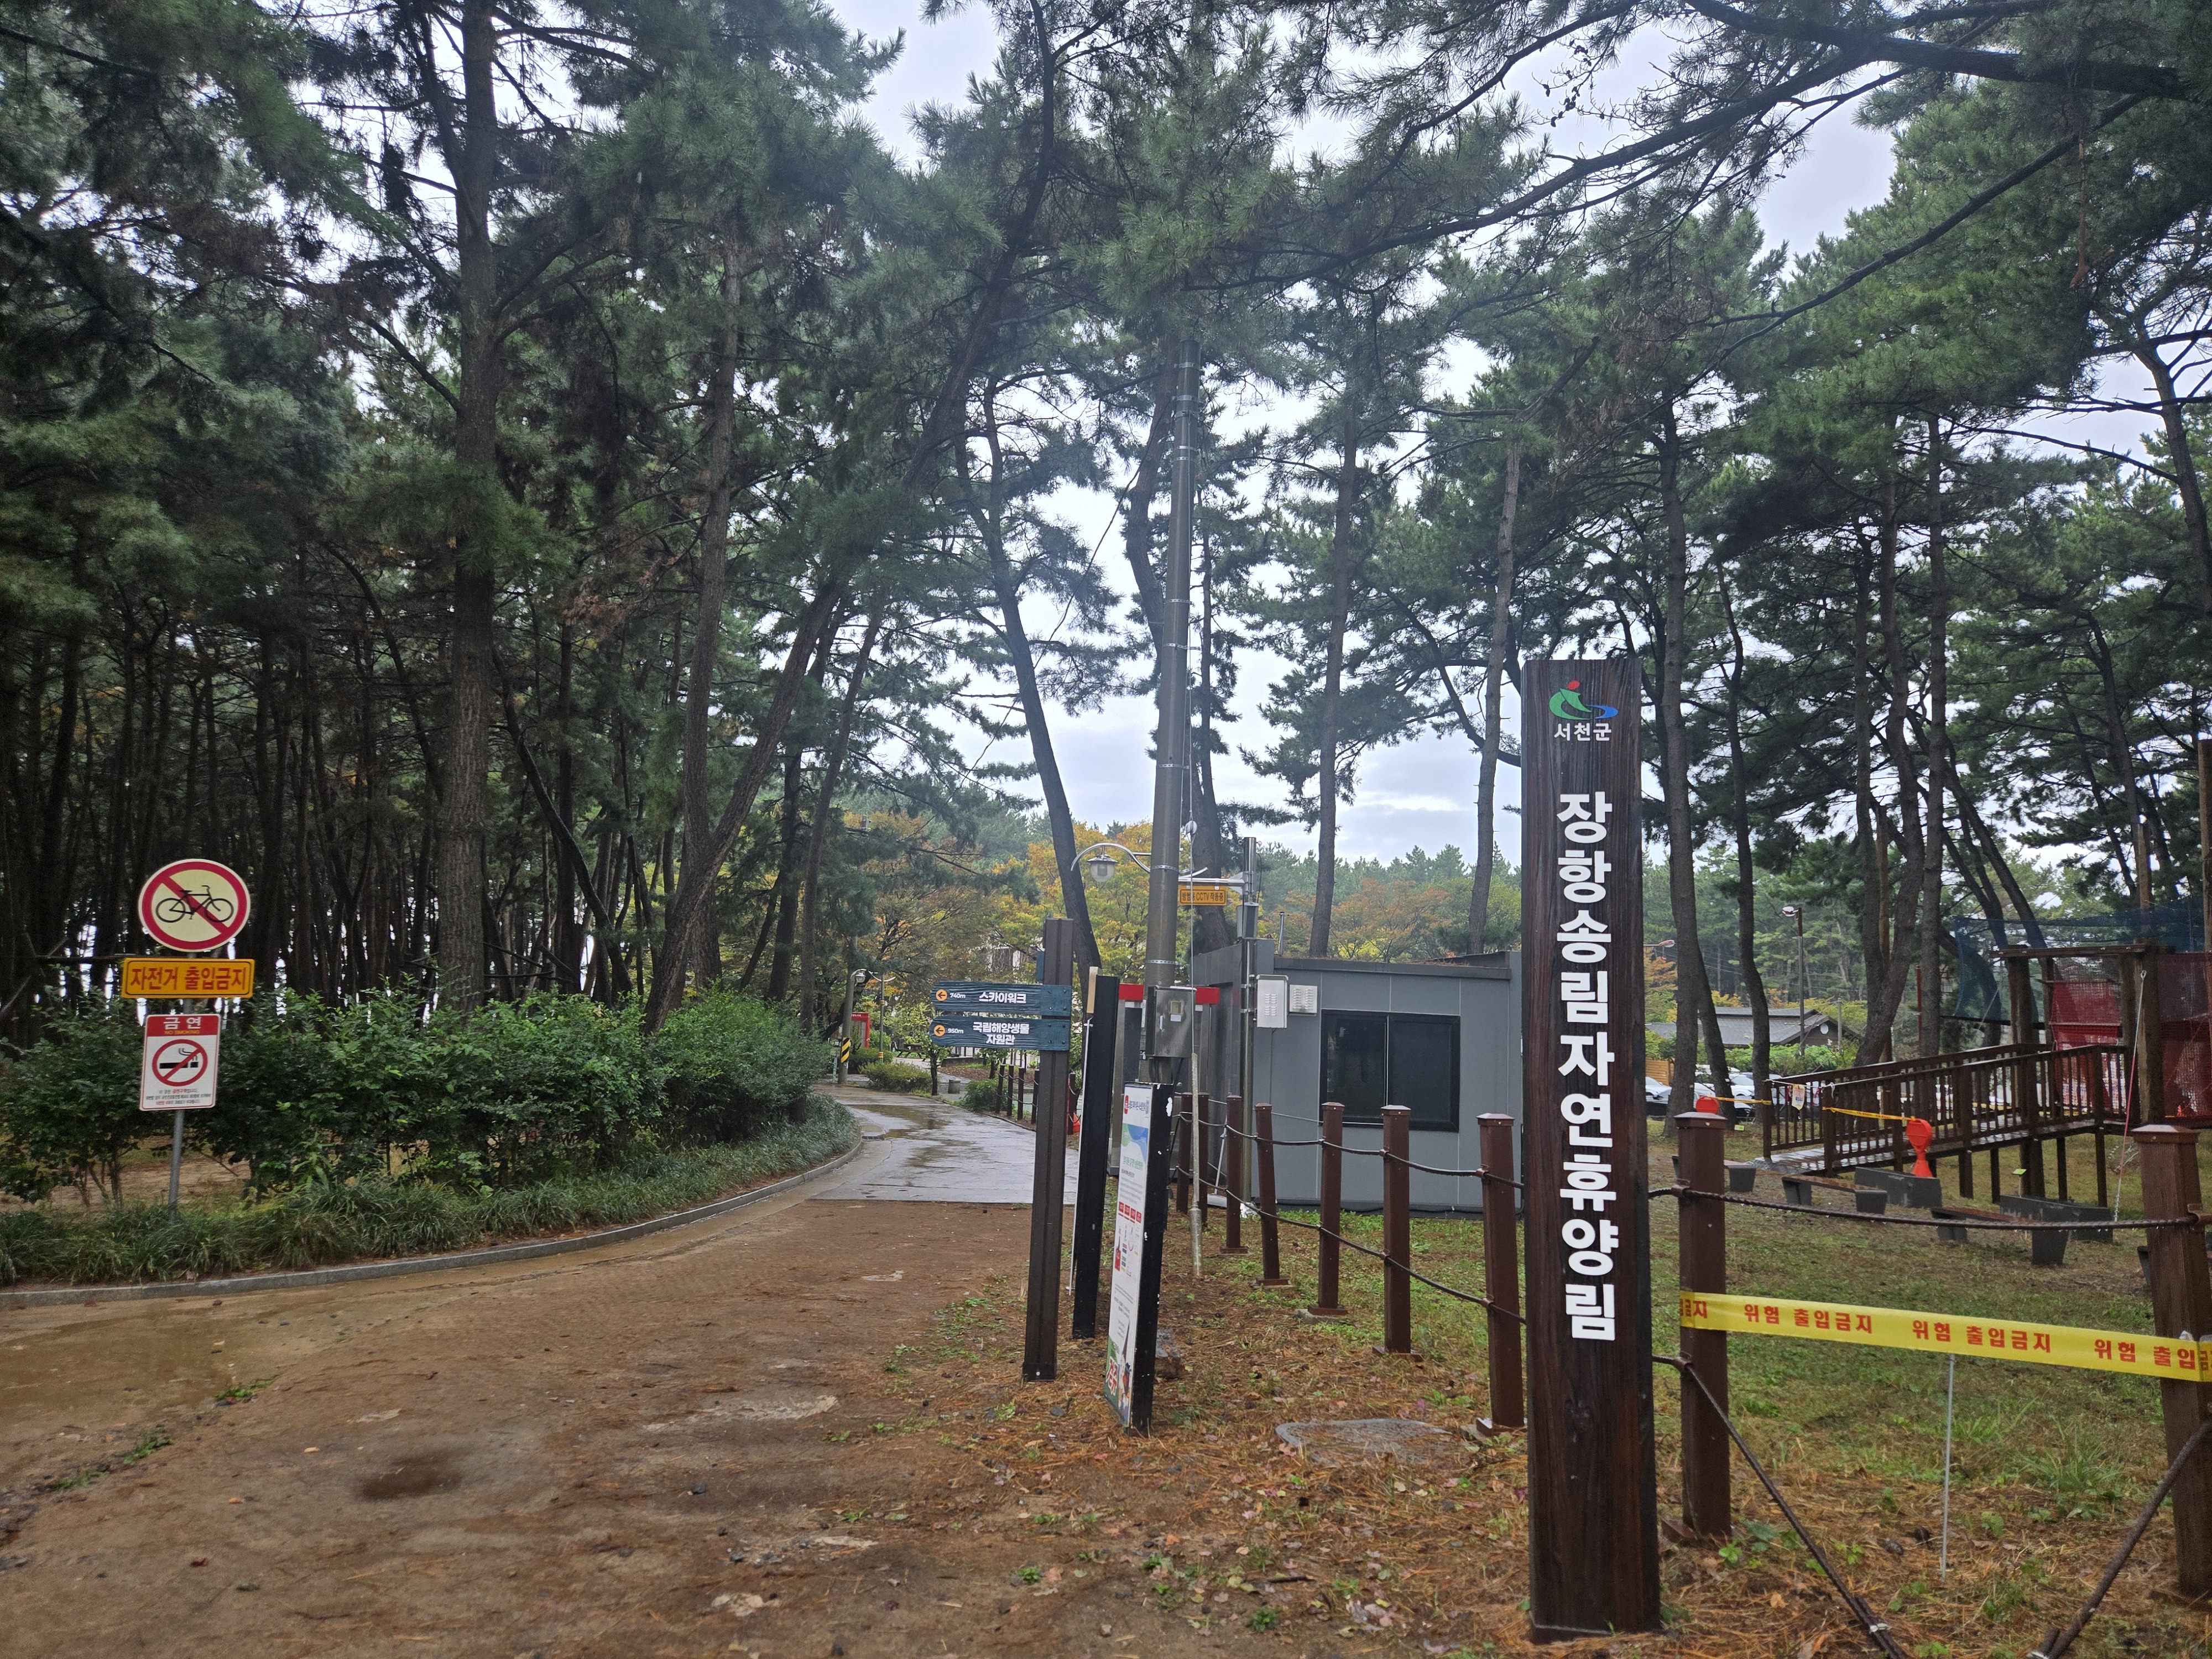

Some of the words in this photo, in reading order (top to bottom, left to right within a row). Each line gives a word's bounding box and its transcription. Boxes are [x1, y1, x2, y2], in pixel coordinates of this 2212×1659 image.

[1554, 723, 1611, 741] 서천군
[1196, 892, 1209, 901] CCTV
[1211, 892, 1223, 901] 작동중
[131, 967, 178, 990] 자전거
[185, 966, 246, 990] 출입금지
[979, 992, 1026, 1004] 스카이워크
[973, 1021, 1030, 1035] 국립해양생물
[986, 1034, 1015, 1045] 자원관
[1557, 791, 1618, 1341] 장항송림자연휴양림
[1744, 1304, 1780, 1324] 위험
[1794, 1308, 1872, 1334] 출입금지
[1912, 1320, 1951, 1342] 위험
[1966, 1326, 2051, 1353] 출입금지
[2094, 1339, 2136, 1363] 위험
[2153, 1345, 2212, 1371] 출입금
